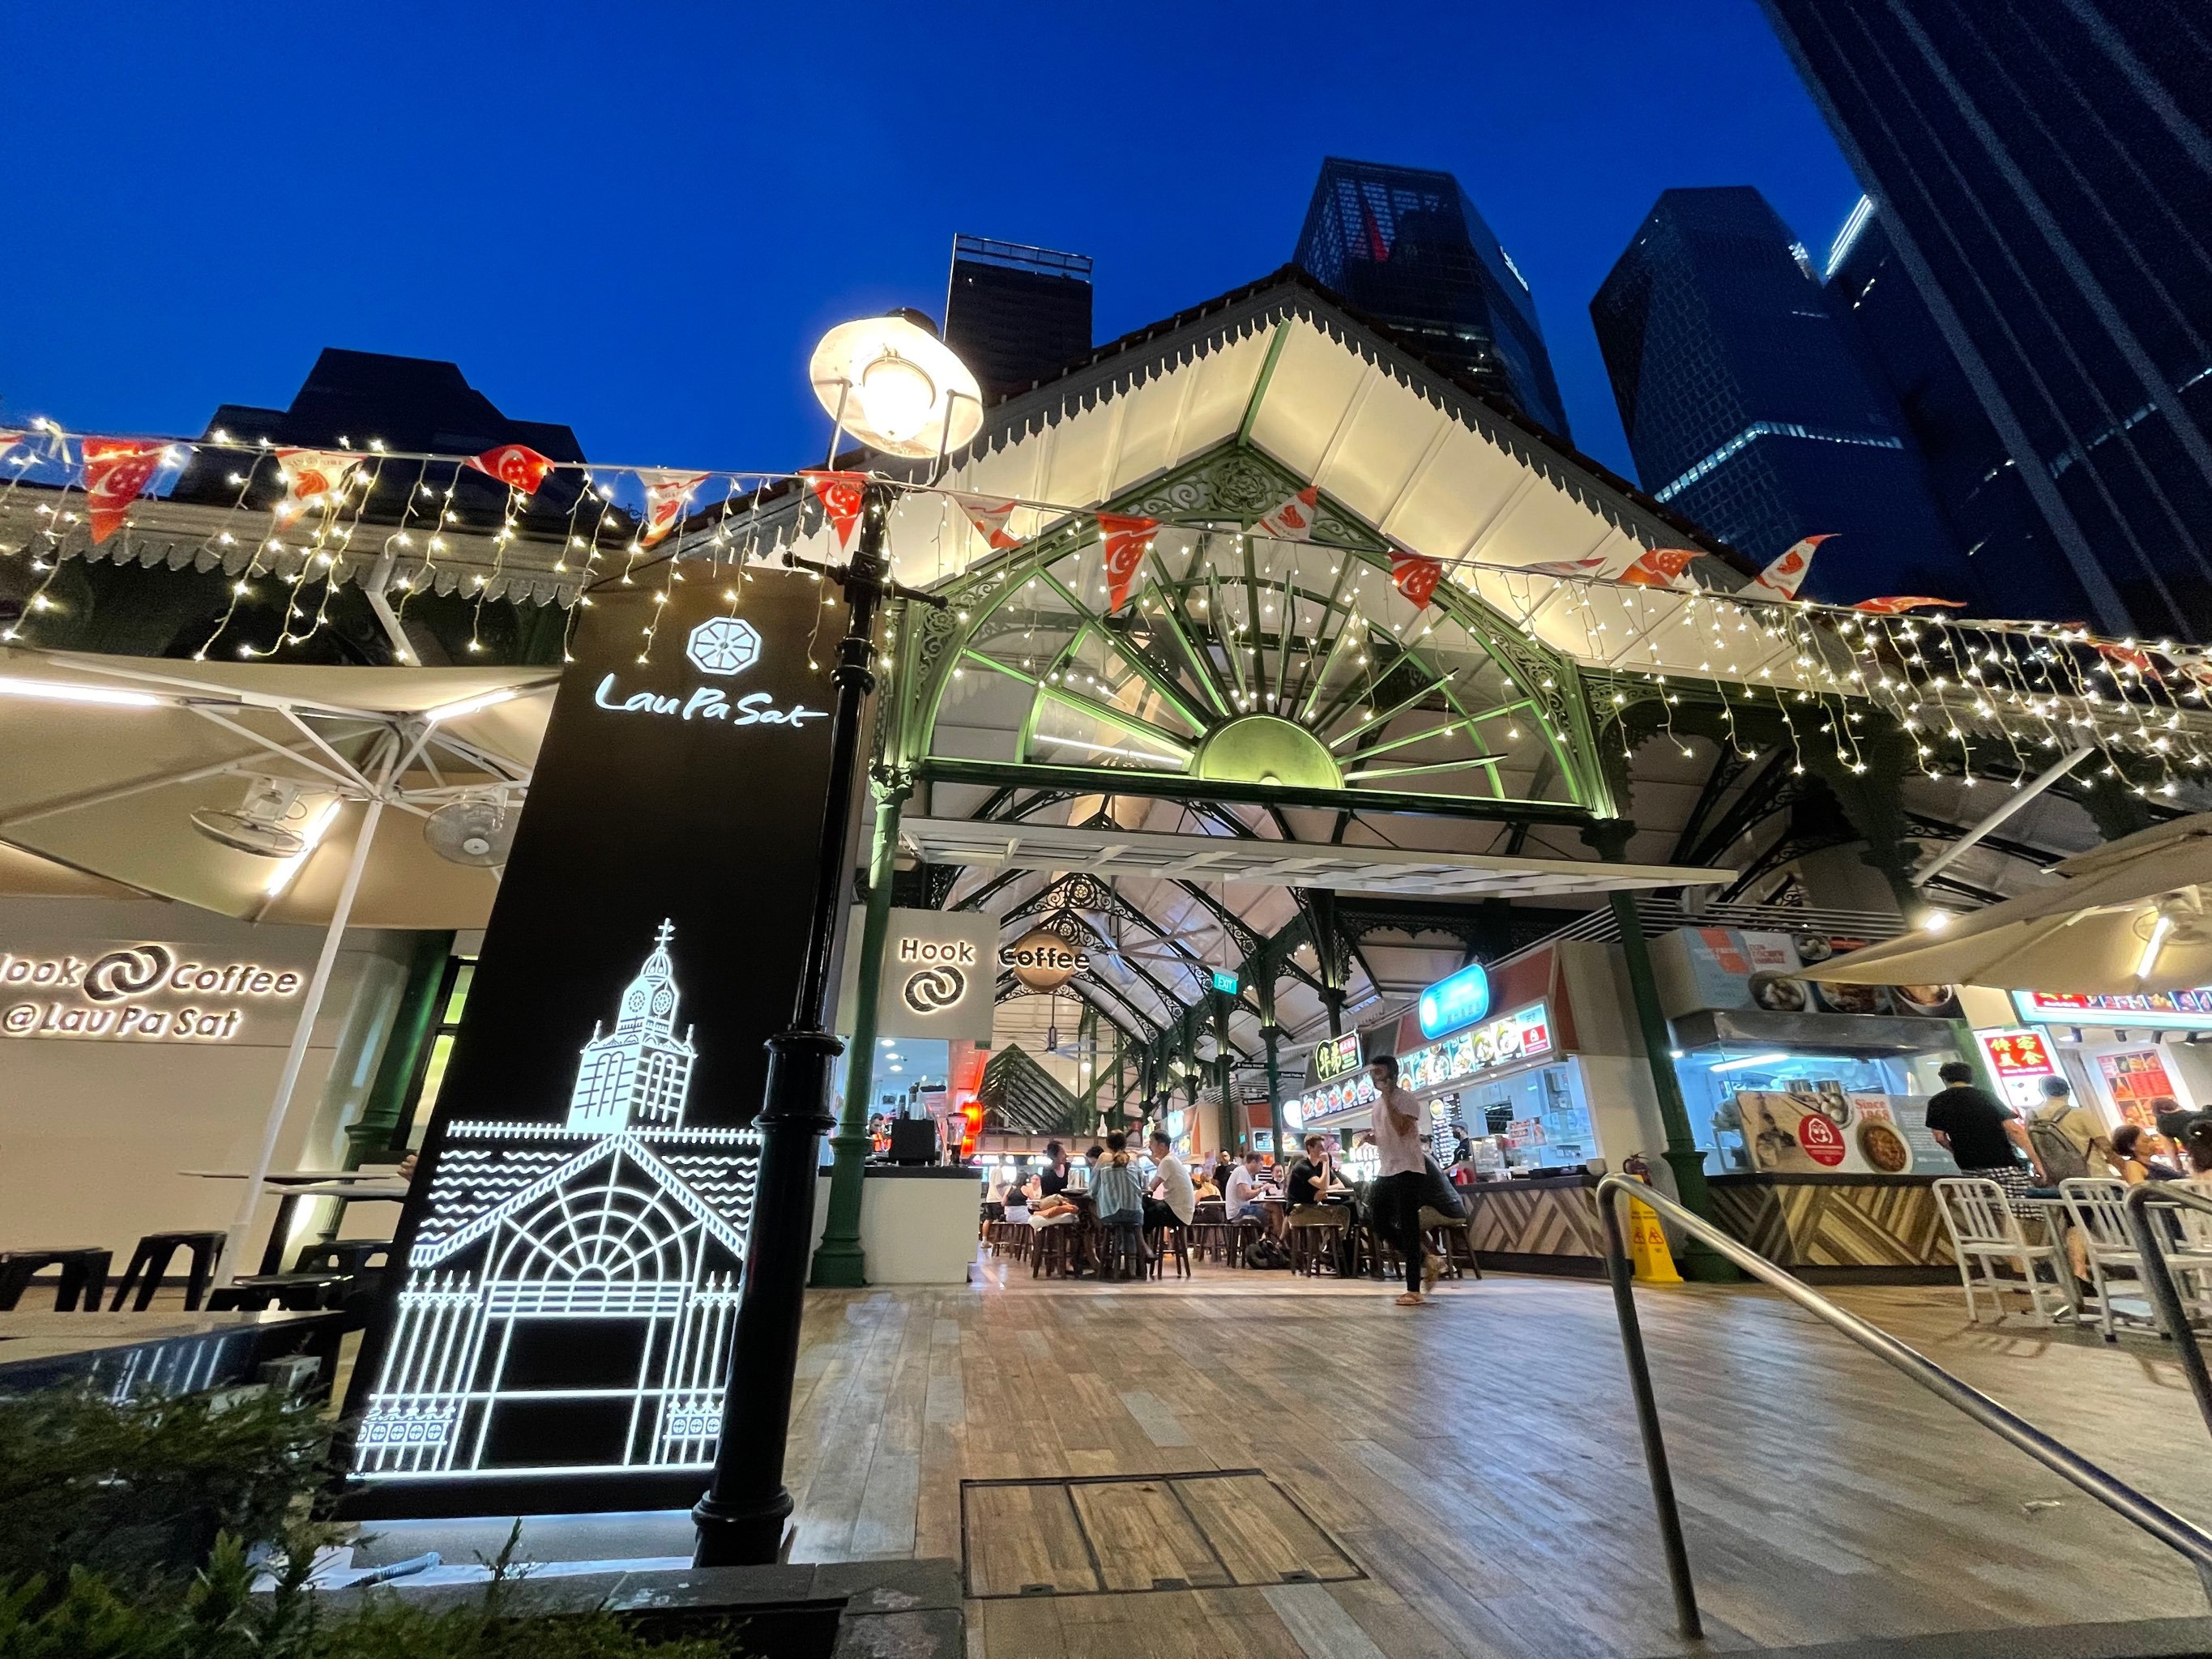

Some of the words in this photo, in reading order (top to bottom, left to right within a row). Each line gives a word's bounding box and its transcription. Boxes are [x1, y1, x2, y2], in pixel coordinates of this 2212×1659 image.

[595, 672, 680, 714] Lau
[682, 687, 731, 720] Pa
[733, 692, 829, 727] Sat
[900, 938, 976, 964] Hook
[999, 946, 1090, 971] Coffee
[169, 964, 300, 994] Coffee
[1218, 976, 1232, 990] EXIT
[2, 1003, 113, 1033] @Lau
[117, 1007, 170, 1035] Pa
[173, 1009, 241, 1037] Sat
[1855, 1098, 1886, 1111] Since
